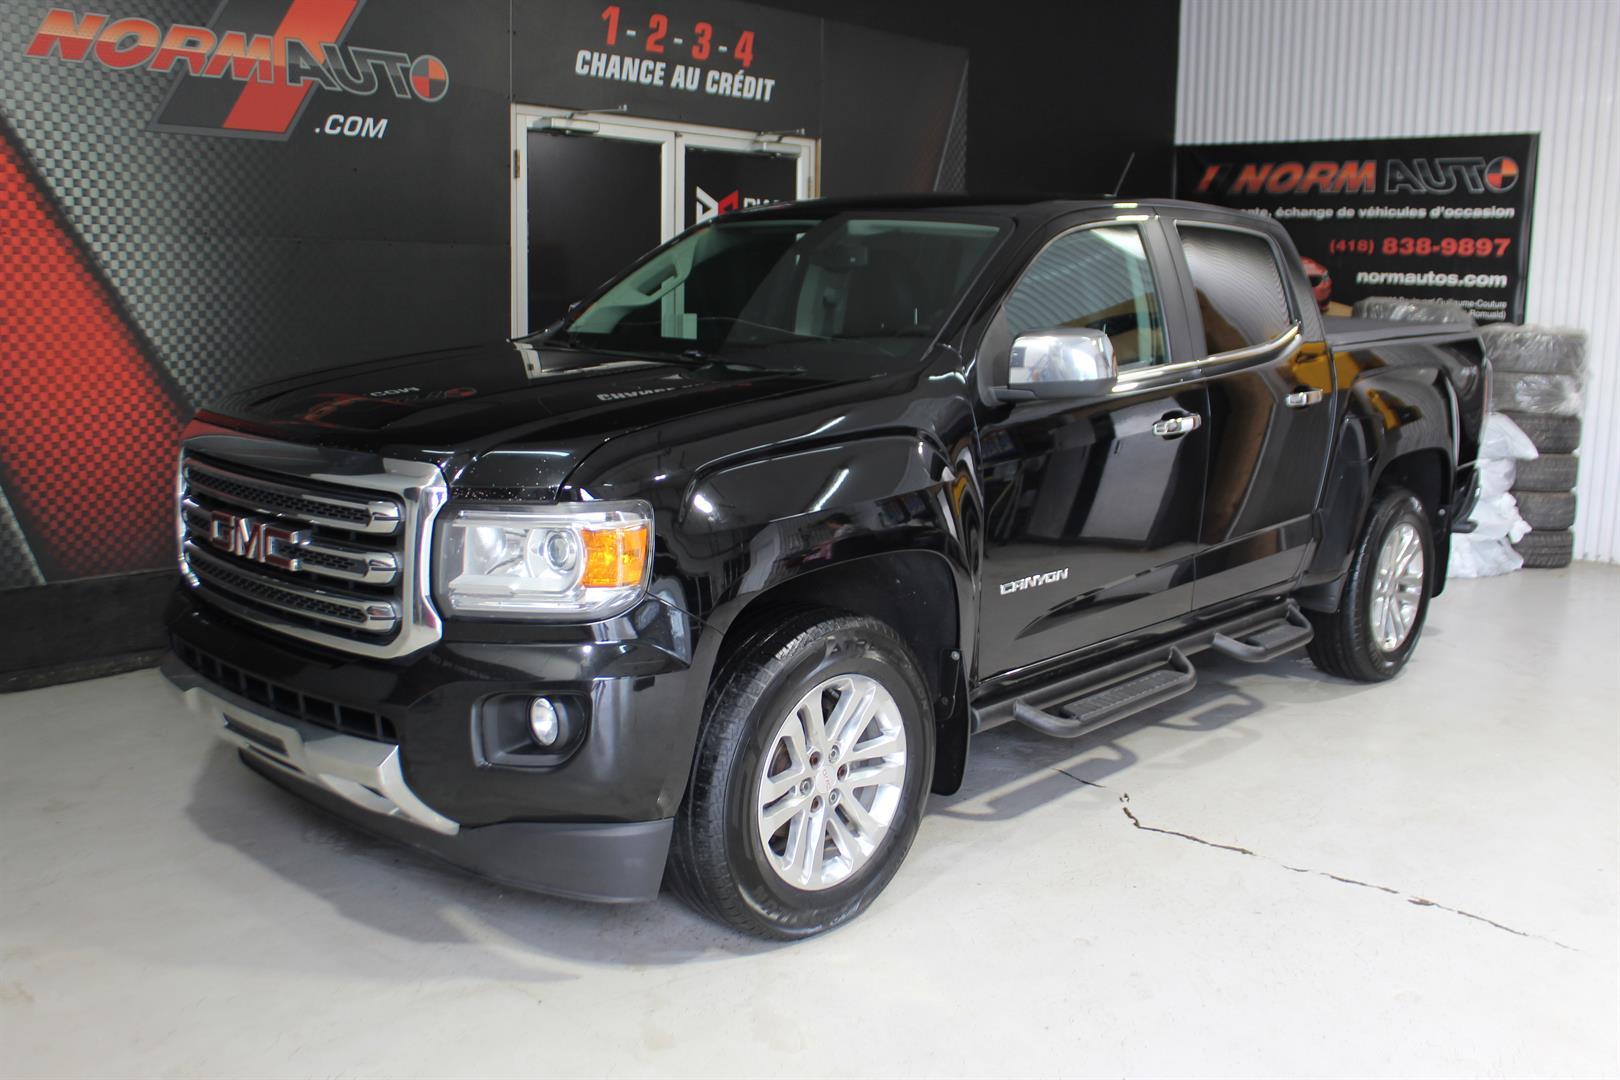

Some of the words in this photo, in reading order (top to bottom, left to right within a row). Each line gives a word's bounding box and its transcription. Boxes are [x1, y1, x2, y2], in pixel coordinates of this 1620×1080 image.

[575, 49, 666, 86] CHANCE
[670, 64, 700, 92] AU
[705, 69, 776, 102] CRÉDIT
[314, 114, 388, 139] .COM
[1231, 158, 1377, 195] NORM
[1275, 206, 1334, 220] échange
[1336, 206, 1356, 218] de
[1358, 205, 1427, 219] véhicules
[1429, 205, 1515, 219] d'occasion
[1329, 239, 1375, 255] (418)
[1382, 236, 1511, 257] 838-9897
[1356, 271, 1508, 288] normautos.com
[209, 510, 302, 572] GMC
[1000, 568, 1069, 595] CANYON
